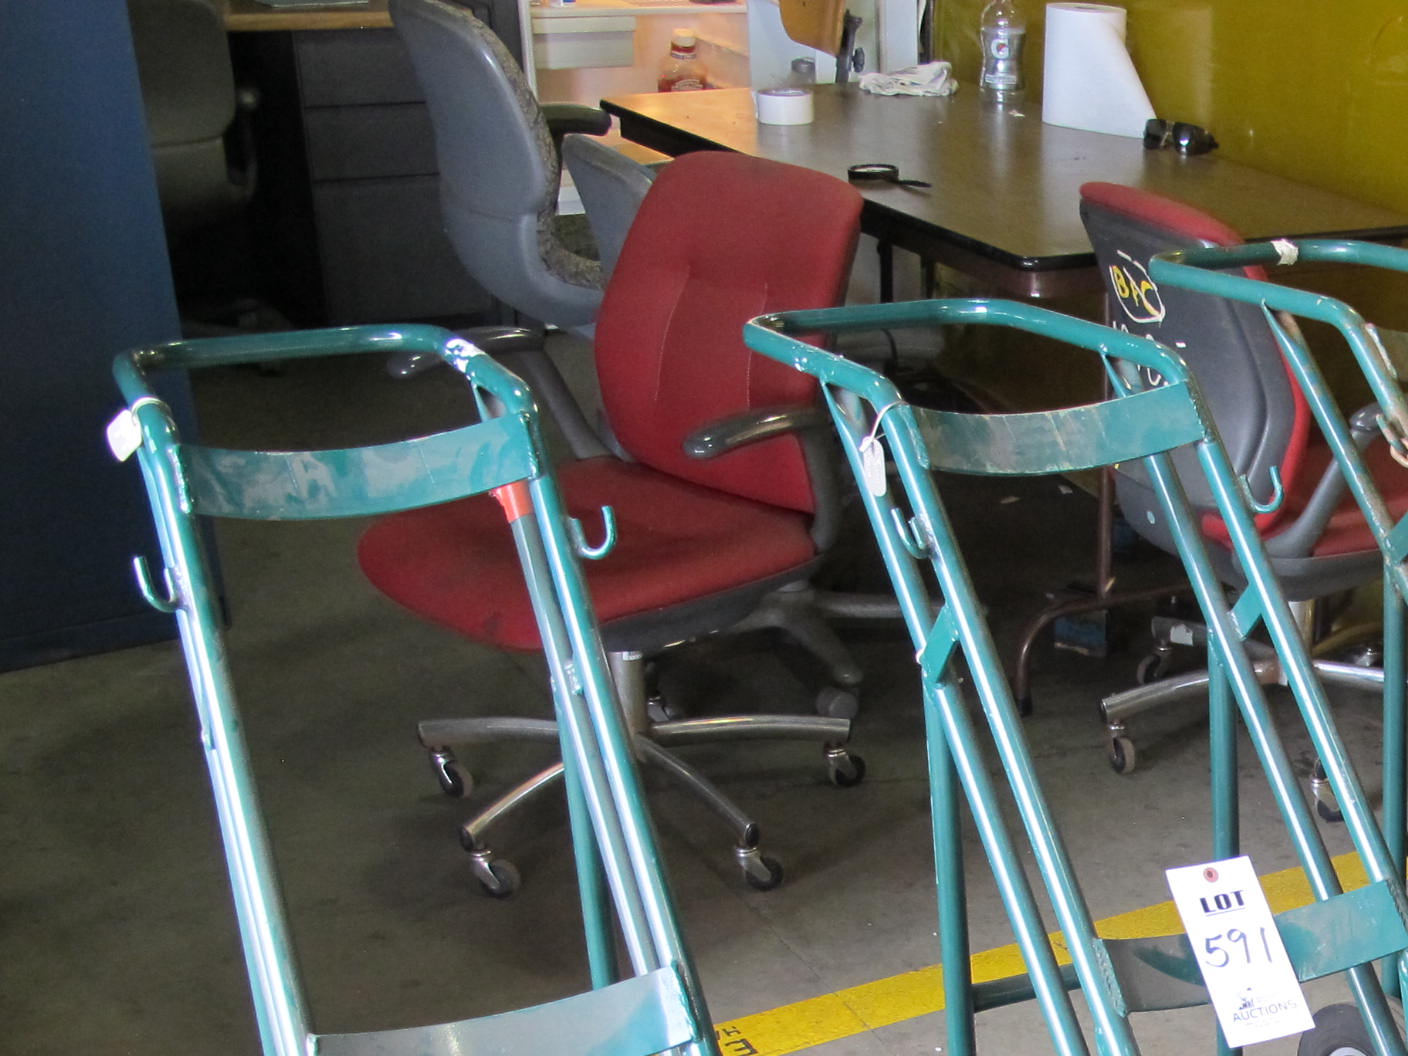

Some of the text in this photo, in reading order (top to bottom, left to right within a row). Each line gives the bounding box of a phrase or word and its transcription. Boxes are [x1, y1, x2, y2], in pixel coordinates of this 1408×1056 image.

[1200, 890, 1245, 913] LOT
[1205, 927, 1272, 968] 591
[1233, 1000, 1297, 1022] AUCTIONS
